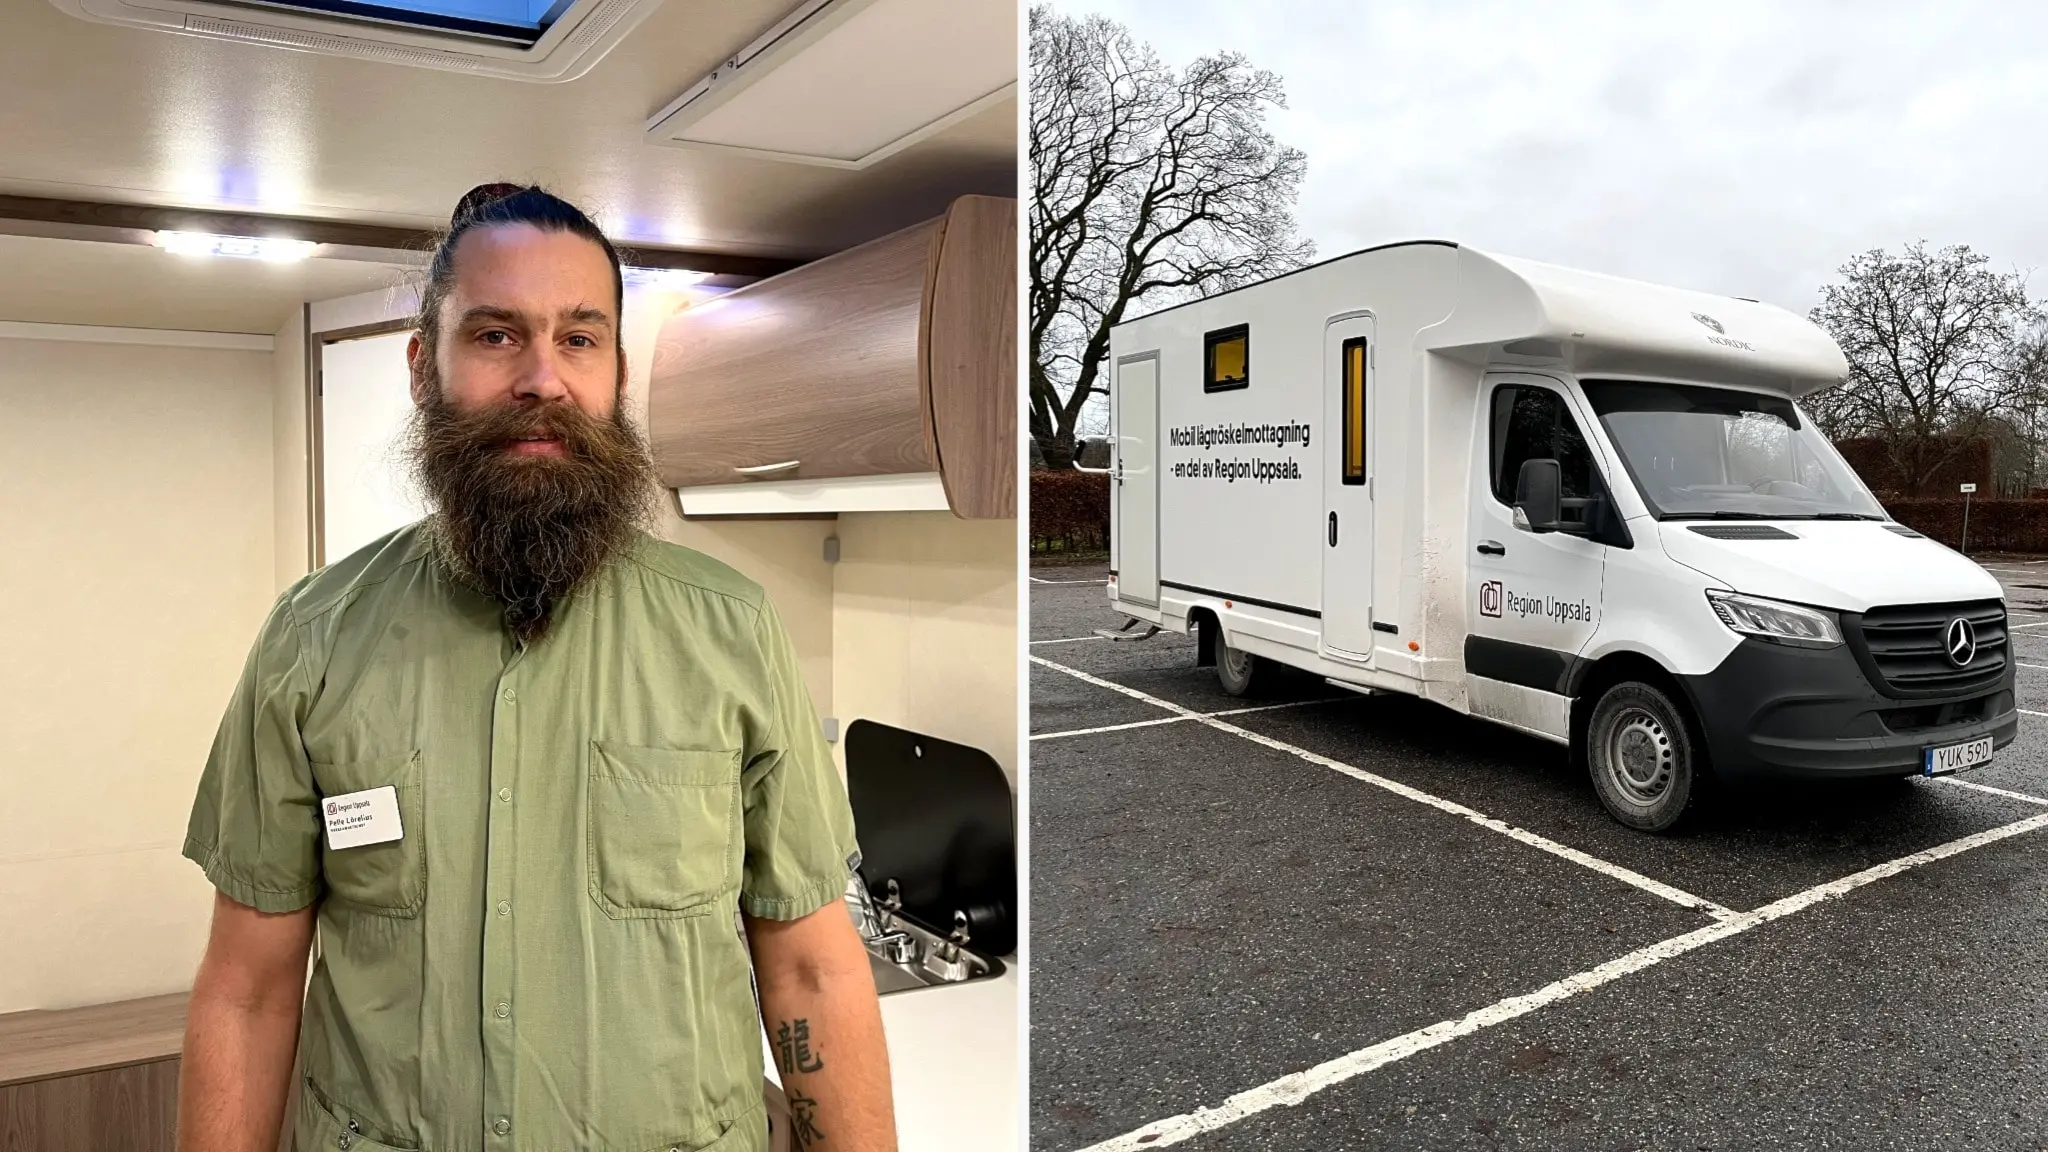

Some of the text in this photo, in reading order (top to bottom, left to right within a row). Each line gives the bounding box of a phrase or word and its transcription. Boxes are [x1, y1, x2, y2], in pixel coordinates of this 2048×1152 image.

[1706, 335, 1756, 352] NORDIC
[1170, 419, 1310, 450] Mobil lågtröskelmottagning
[1175, 462, 1186, 478] en
[1186, 457, 1201, 478] del
[1202, 462, 1214, 478] av
[1214, 456, 1250, 483] Region
[1251, 455, 1302, 485] Uppsala.
[1507, 591, 1591, 624] Region Uppsala
[1939, 741, 1988, 769] YUK 59D
